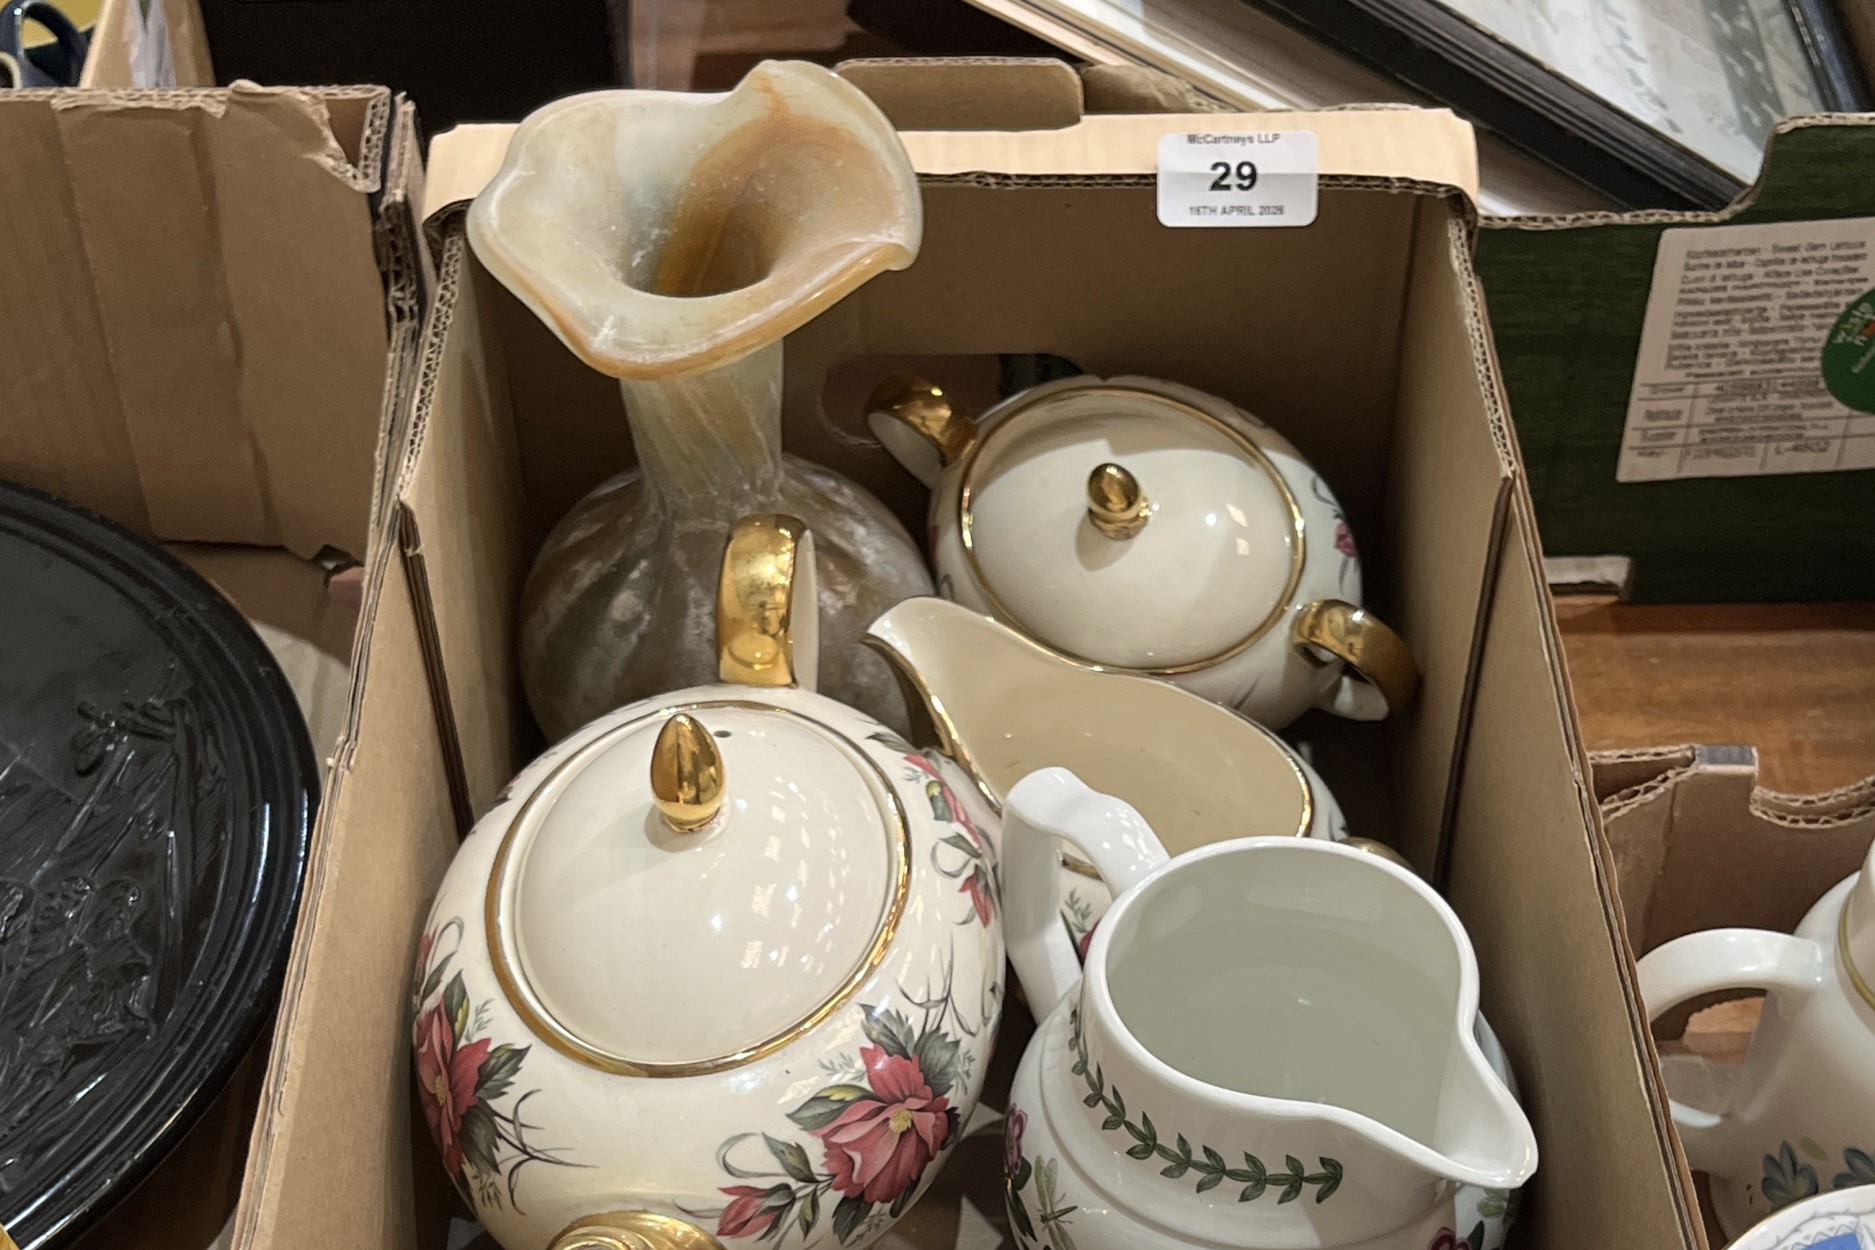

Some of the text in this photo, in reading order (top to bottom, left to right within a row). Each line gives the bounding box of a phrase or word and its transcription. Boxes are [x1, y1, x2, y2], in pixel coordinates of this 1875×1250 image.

[1187, 133, 1281, 146] McCartneys LLP
[1209, 161, 1258, 191] 29
[1220, 205, 1255, 216] APRIL
